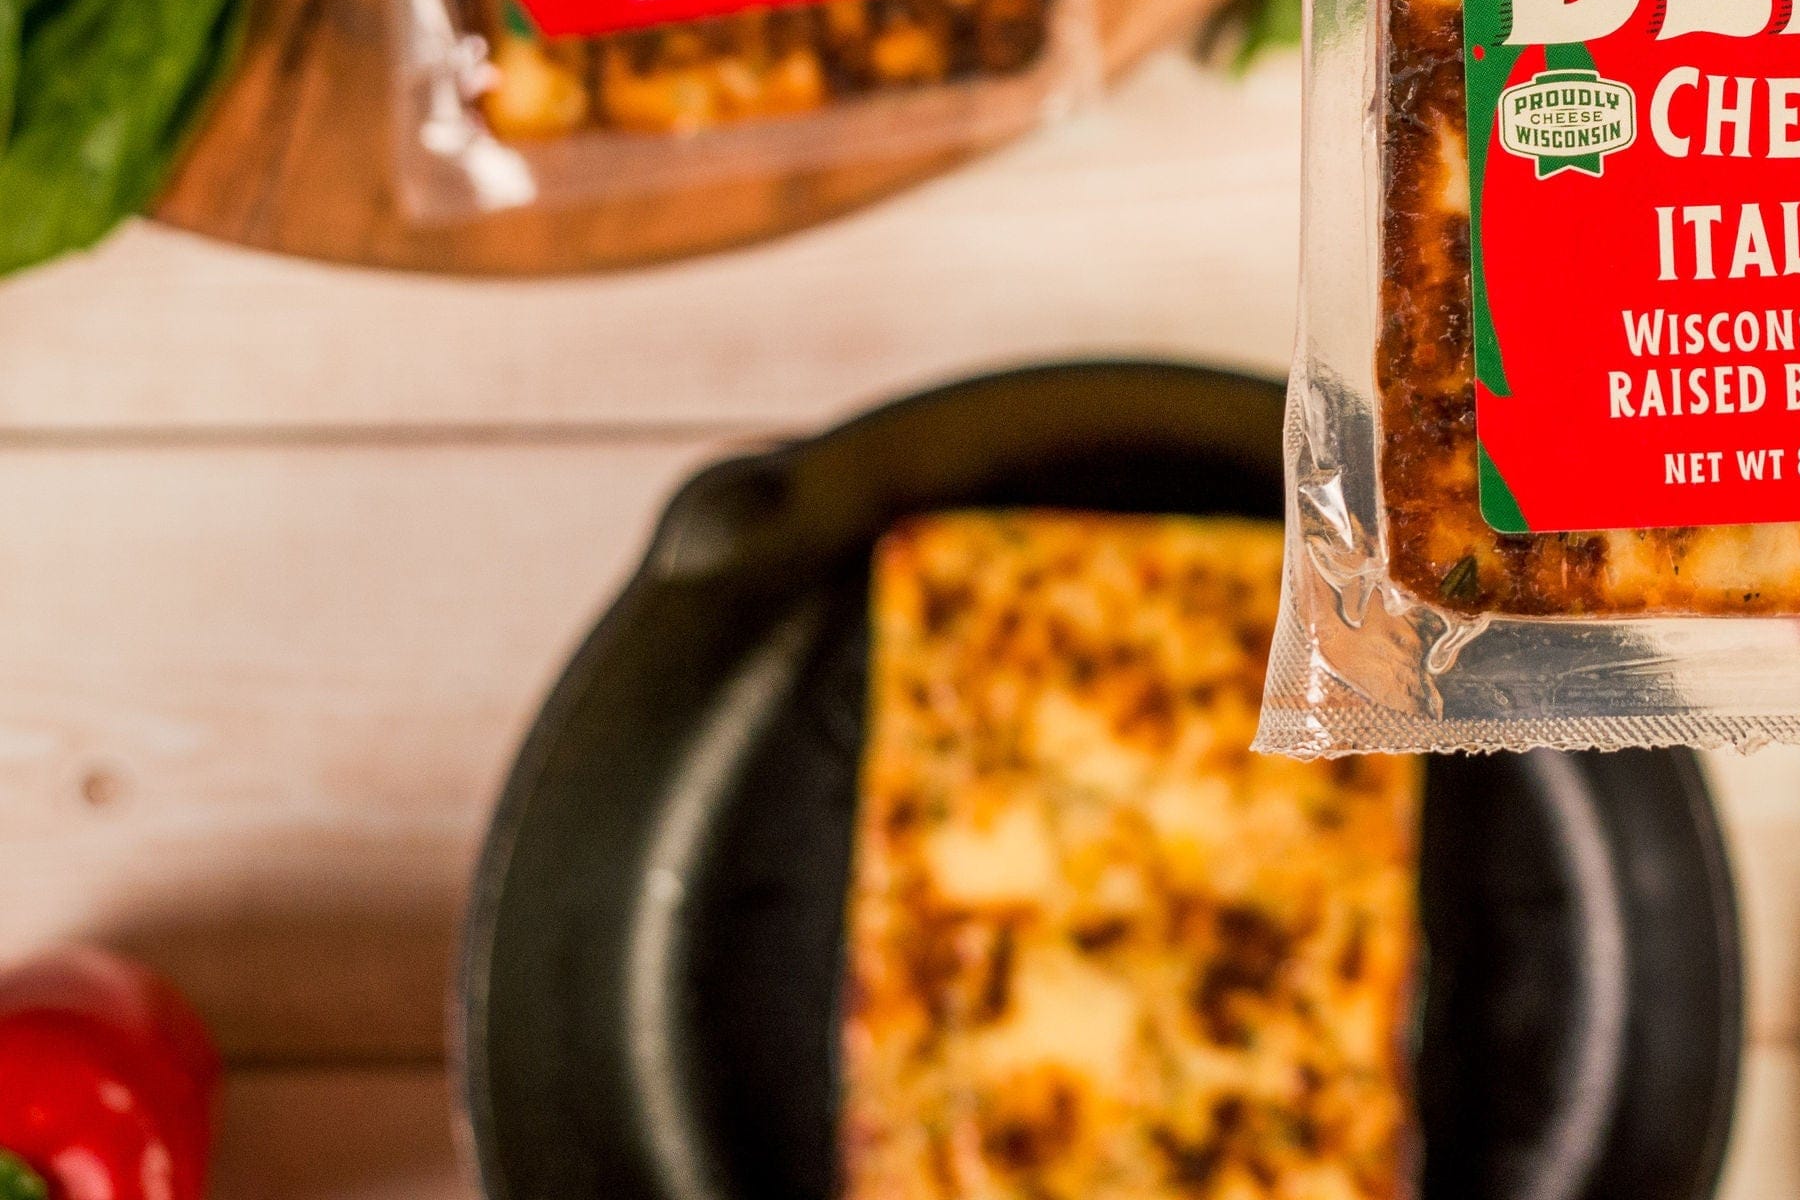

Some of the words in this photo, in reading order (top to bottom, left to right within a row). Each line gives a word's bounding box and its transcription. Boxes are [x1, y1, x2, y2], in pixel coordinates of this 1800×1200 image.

[1514, 88, 1620, 116] PROUDLY
[1530, 111, 1603, 125] CHEESE
[1515, 120, 1621, 148] WISCONSIN
[1608, 364, 1766, 419] RAISED
[1664, 450, 1723, 485] NET
[1736, 447, 1784, 481] WT
